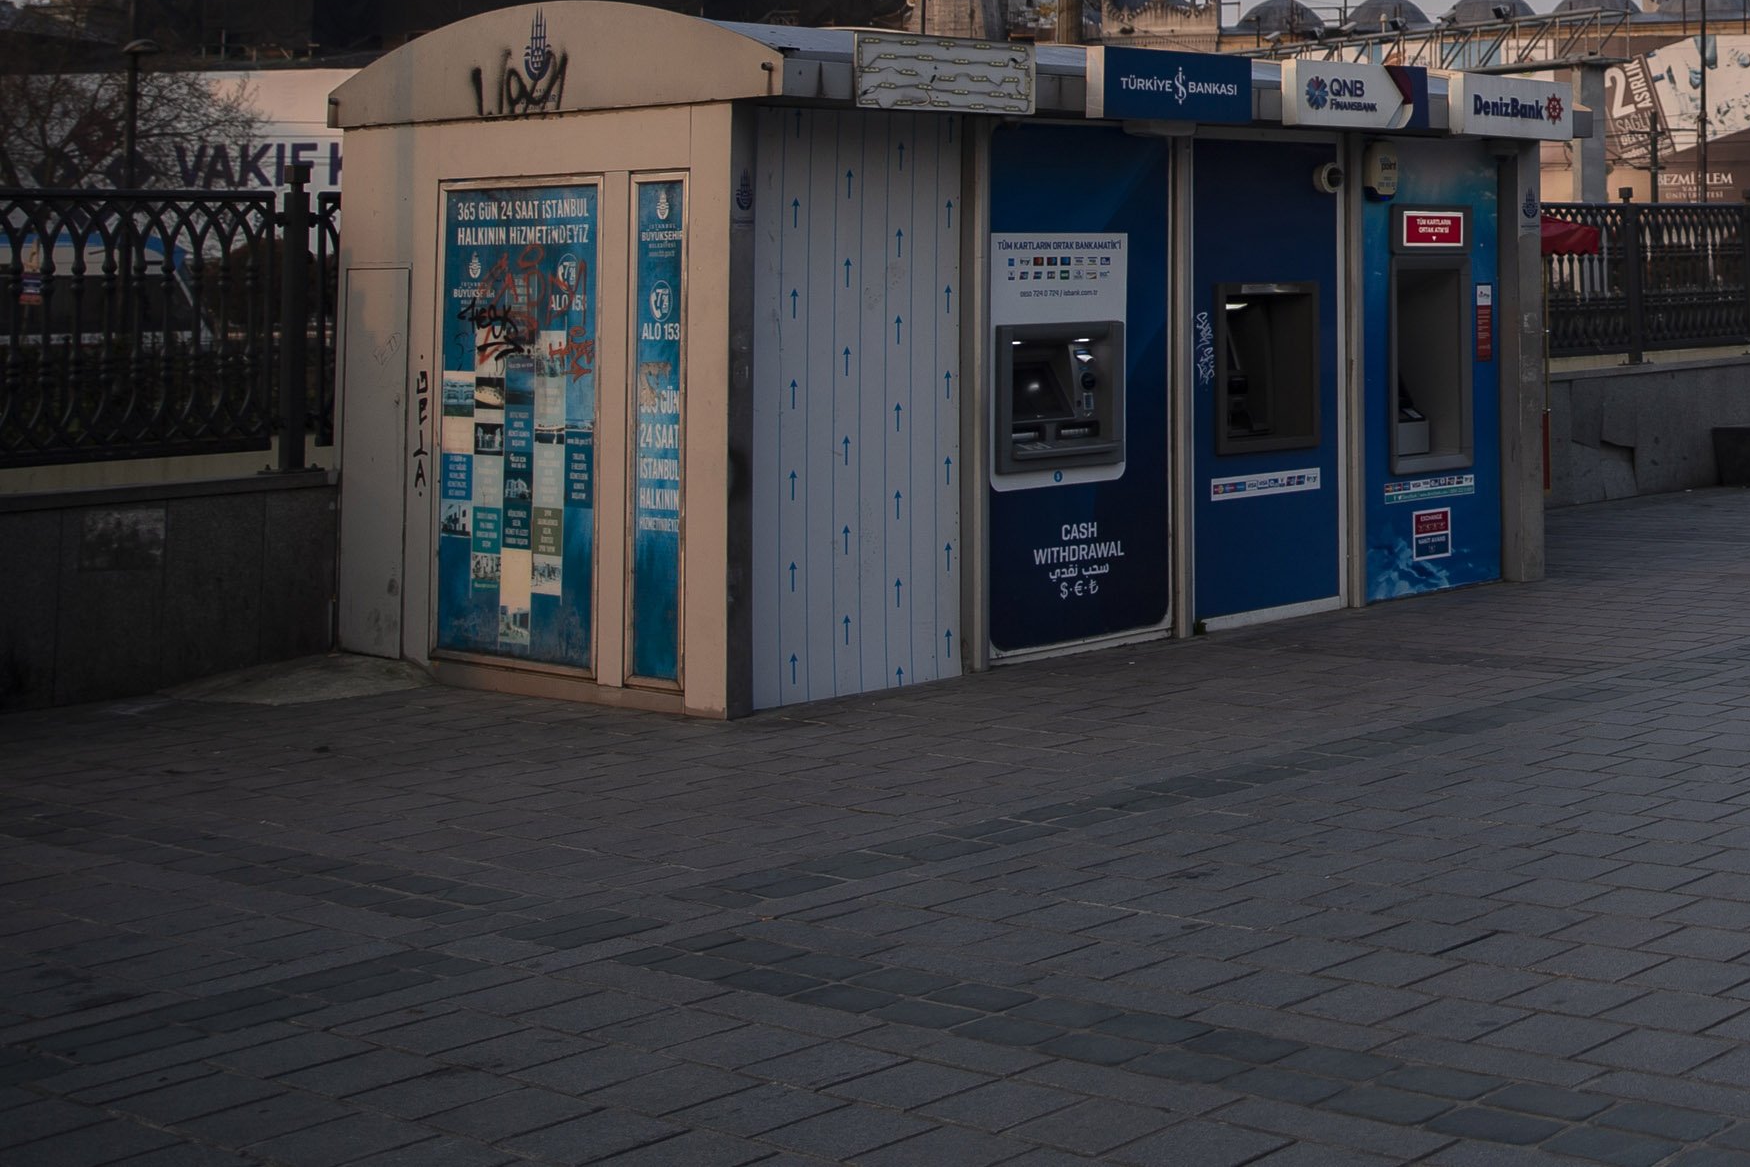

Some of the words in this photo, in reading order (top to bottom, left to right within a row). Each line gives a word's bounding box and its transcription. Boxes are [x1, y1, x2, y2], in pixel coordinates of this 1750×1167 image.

[1120, 73, 1173, 92] TÜRKİYE
[1188, 80, 1238, 96] BANKASI
[1330, 78, 1365, 97] QNB
[1623, 59, 1654, 109] ASIRLIK
[1473, 93, 1544, 121] DenizBank
[1657, 171, 1734, 186] BEZMİLEM
[457, 202, 476, 221] 365
[478, 200, 498, 220] GÜN
[500, 201, 512, 219] 24
[515, 200, 539, 219] SAAT
[542, 198, 589, 219] İSTANBUL
[457, 226, 507, 245] HALKININ
[509, 224, 589, 245] HİZMETİNDEYİZ
[998, 240, 1013, 250] TÜM
[1014, 241, 1052, 250] KARTLARIN
[1053, 241, 1075, 250] ORTAK
[641, 323, 661, 340] ALO
[664, 323, 680, 341] 153
[640, 424, 652, 448] 24
[655, 424, 680, 449] SAAT
[640, 453, 680, 480] İSTANBUL
[640, 487, 679, 511] HALKININ
[1061, 522, 1098, 541] CASH
[1033, 540, 1126, 565] WITHDRAWAL
[1049, 564, 1079, 582] نقدي
[1081, 563, 1110, 579] سحب
